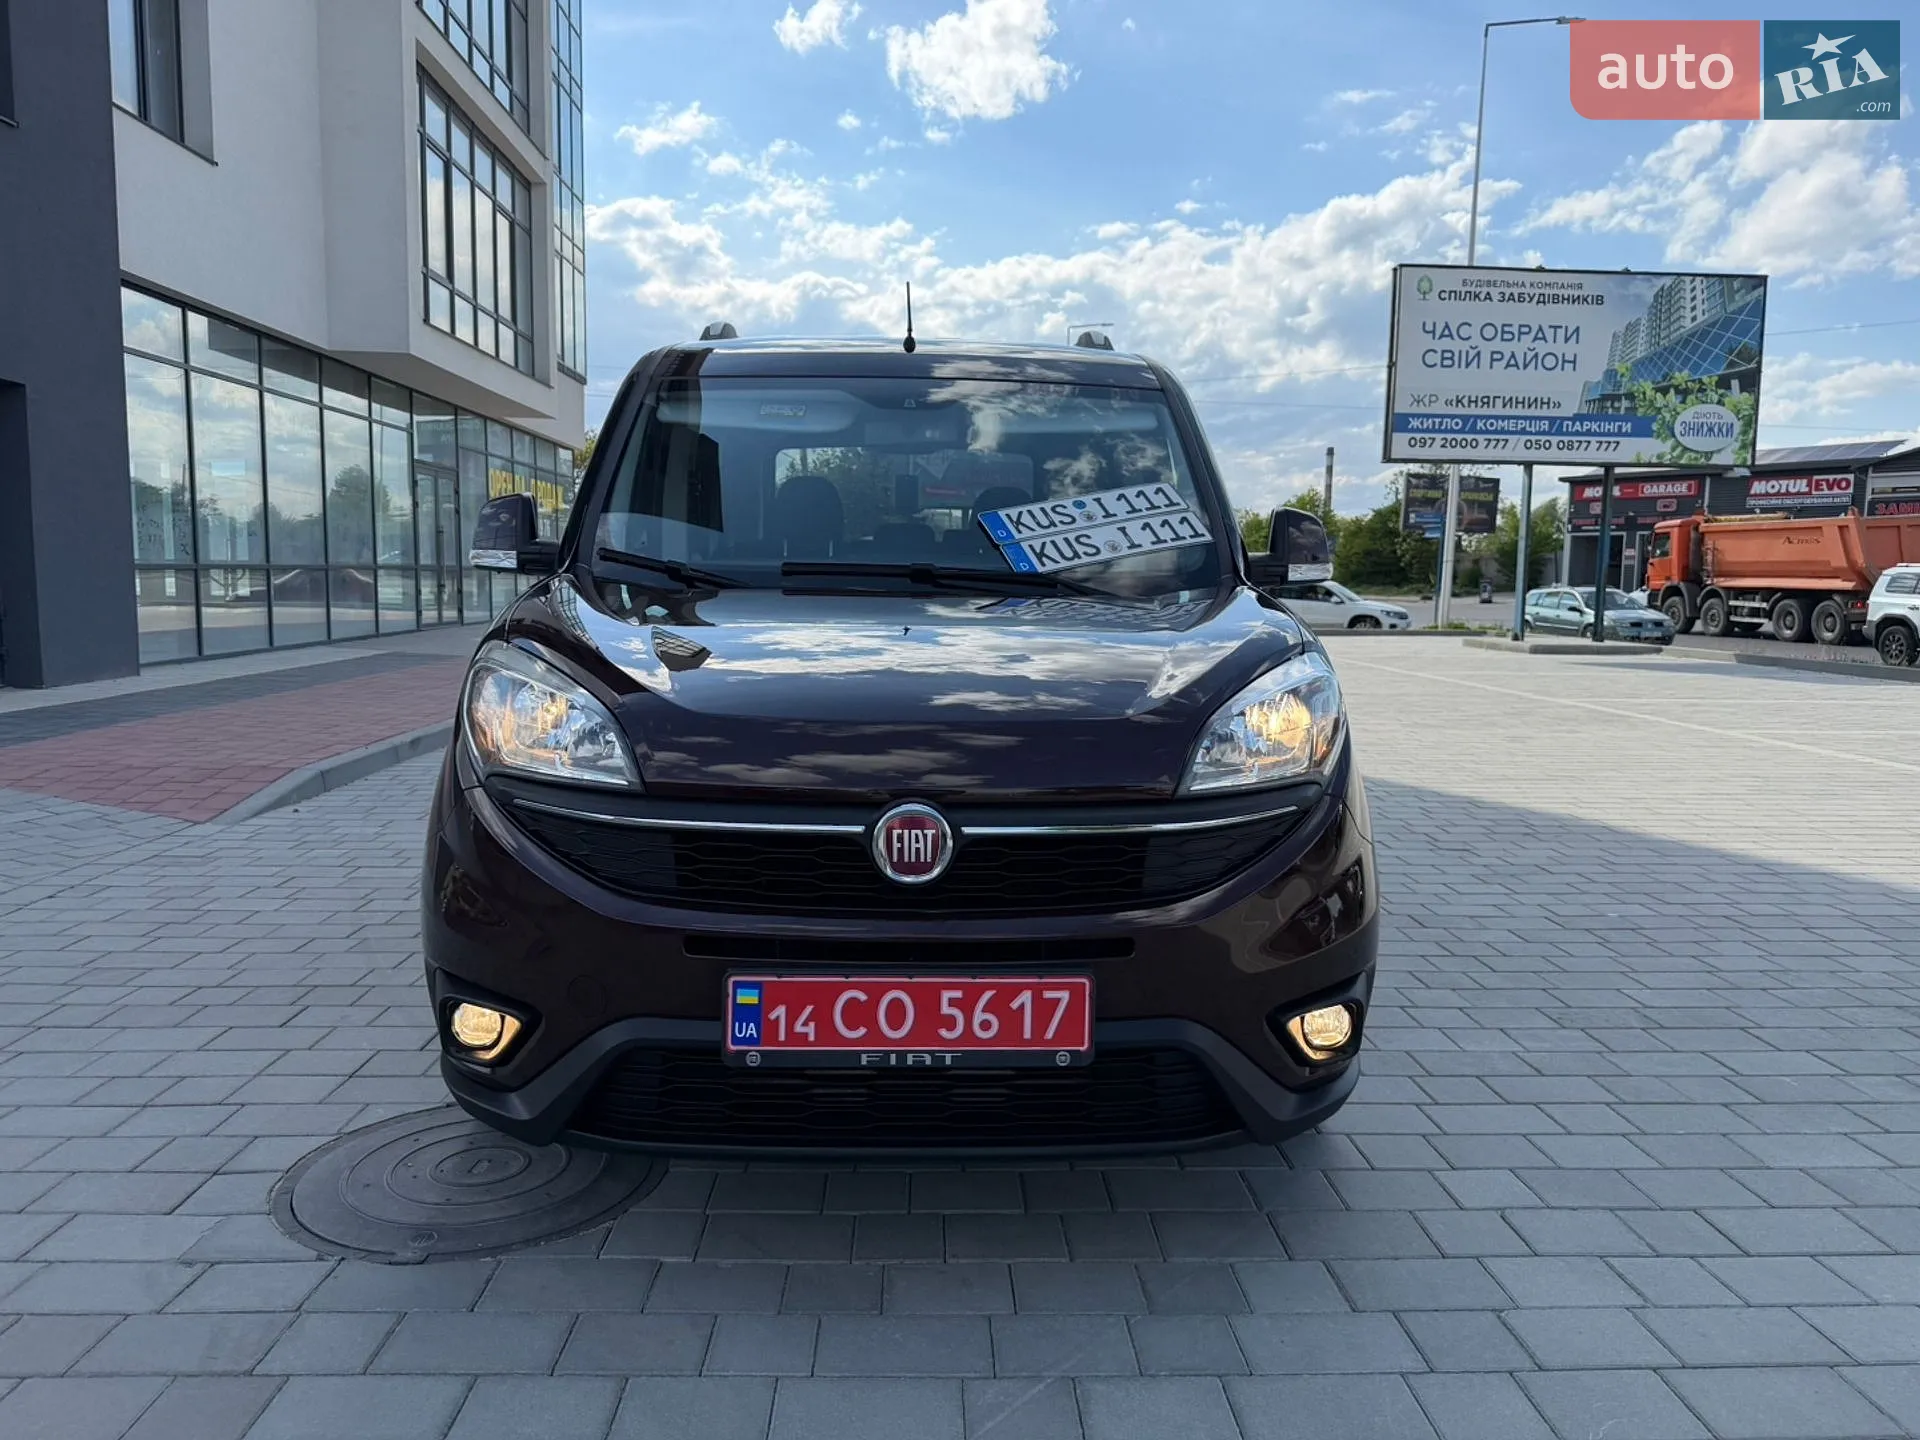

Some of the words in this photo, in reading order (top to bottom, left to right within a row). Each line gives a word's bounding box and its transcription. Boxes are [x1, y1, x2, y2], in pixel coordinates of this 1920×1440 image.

[1462, 278, 1526, 290] БУДІВЕЛЬНА
[1530, 281, 1583, 290] КОМПАНІЯ
[1438, 290, 1493, 302] СПІЛКА
[1497, 292, 1605, 306] ЗАБУДІВНИКІВ
[1422, 321, 1473, 341] ЧАС
[1480, 322, 1581, 344] ОБРАТИ
[1422, 346, 1481, 369] СВІЙ
[1489, 348, 1577, 372] РАЙОН
[1409, 393, 1438, 407] ЖР
[1444, 394, 1562, 410] «КНЯГИНИН»
[1692, 411, 1724, 420] ДІЮТЬ
[1408, 417, 1463, 430] ЖИТЛО
[1476, 419, 1549, 434] КОМЕРЦІЯ
[1563, 420, 1632, 434] ПАРКІНГИ
[1680, 420, 1734, 438] ЗНИЖКИ
[1408, 436, 1436, 448] 097
[1440, 437, 1479, 449] 2000
[1484, 438, 1509, 450] 777
[1524, 438, 1552, 451] 050
[1556, 439, 1591, 451] 0877
[1595, 440, 1621, 452] 777
[1643, 483, 1689, 494] GARAGE
[1750, 478, 1809, 494] MOTUL
[1814, 477, 1852, 492] EVO
[1005, 503, 1077, 534] KUS
[1117, 486, 1181, 514] 111
[1028, 533, 1101, 567] KUS
[1141, 515, 1205, 545] 111
[892, 829, 936, 863] FIAT
[734, 1022, 757, 1039] UA
[768, 1004, 816, 1042] 14
[832, 989, 915, 1039] CO
[937, 989, 1070, 1040] 5617
[861, 1053, 962, 1065] FIAT
